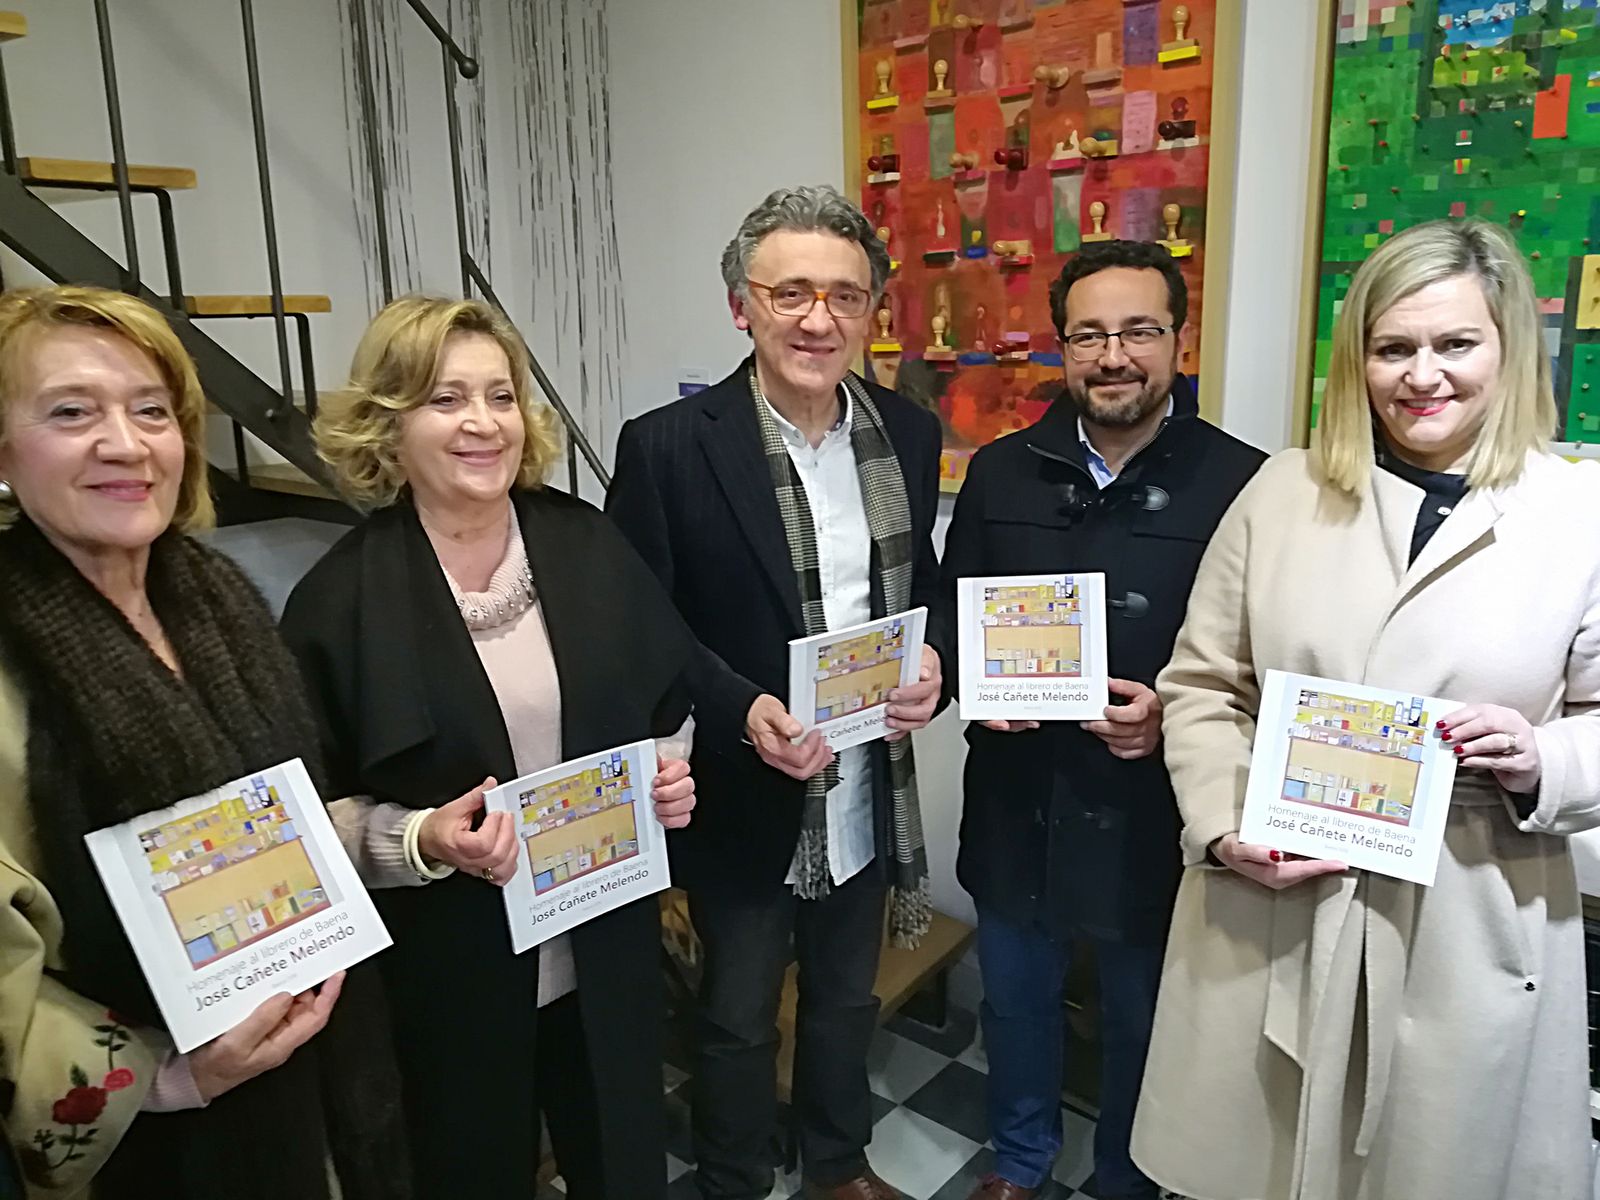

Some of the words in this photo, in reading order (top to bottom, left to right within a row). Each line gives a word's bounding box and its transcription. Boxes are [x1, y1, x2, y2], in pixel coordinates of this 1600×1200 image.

[977, 692, 1000, 702] José
[1003, 691, 1039, 702] Cañete
[1042, 692, 1089, 702] Melendo
[1266, 815, 1296, 831] José
[1300, 822, 1347, 842] Cañete
[1351, 833, 1413, 858] Melendo
[1268, 803, 1319, 823] Homenaje
[1321, 814, 1330, 824] al
[1332, 816, 1365, 832] librero
[1368, 825, 1382, 835] de
[1384, 828, 1416, 844] Baena
[531, 907, 557, 925] José
[558, 889, 598, 912] Cañete
[600, 869, 649, 894] Melendo
[186, 959, 247, 994] Homenaje
[249, 951, 259, 965] al
[261, 936, 298, 958] librero
[299, 928, 314, 941] de
[315, 910, 349, 933] Baena
[195, 985, 232, 1011] José
[233, 958, 289, 991] Cañete
[290, 924, 356, 964] Melendo
